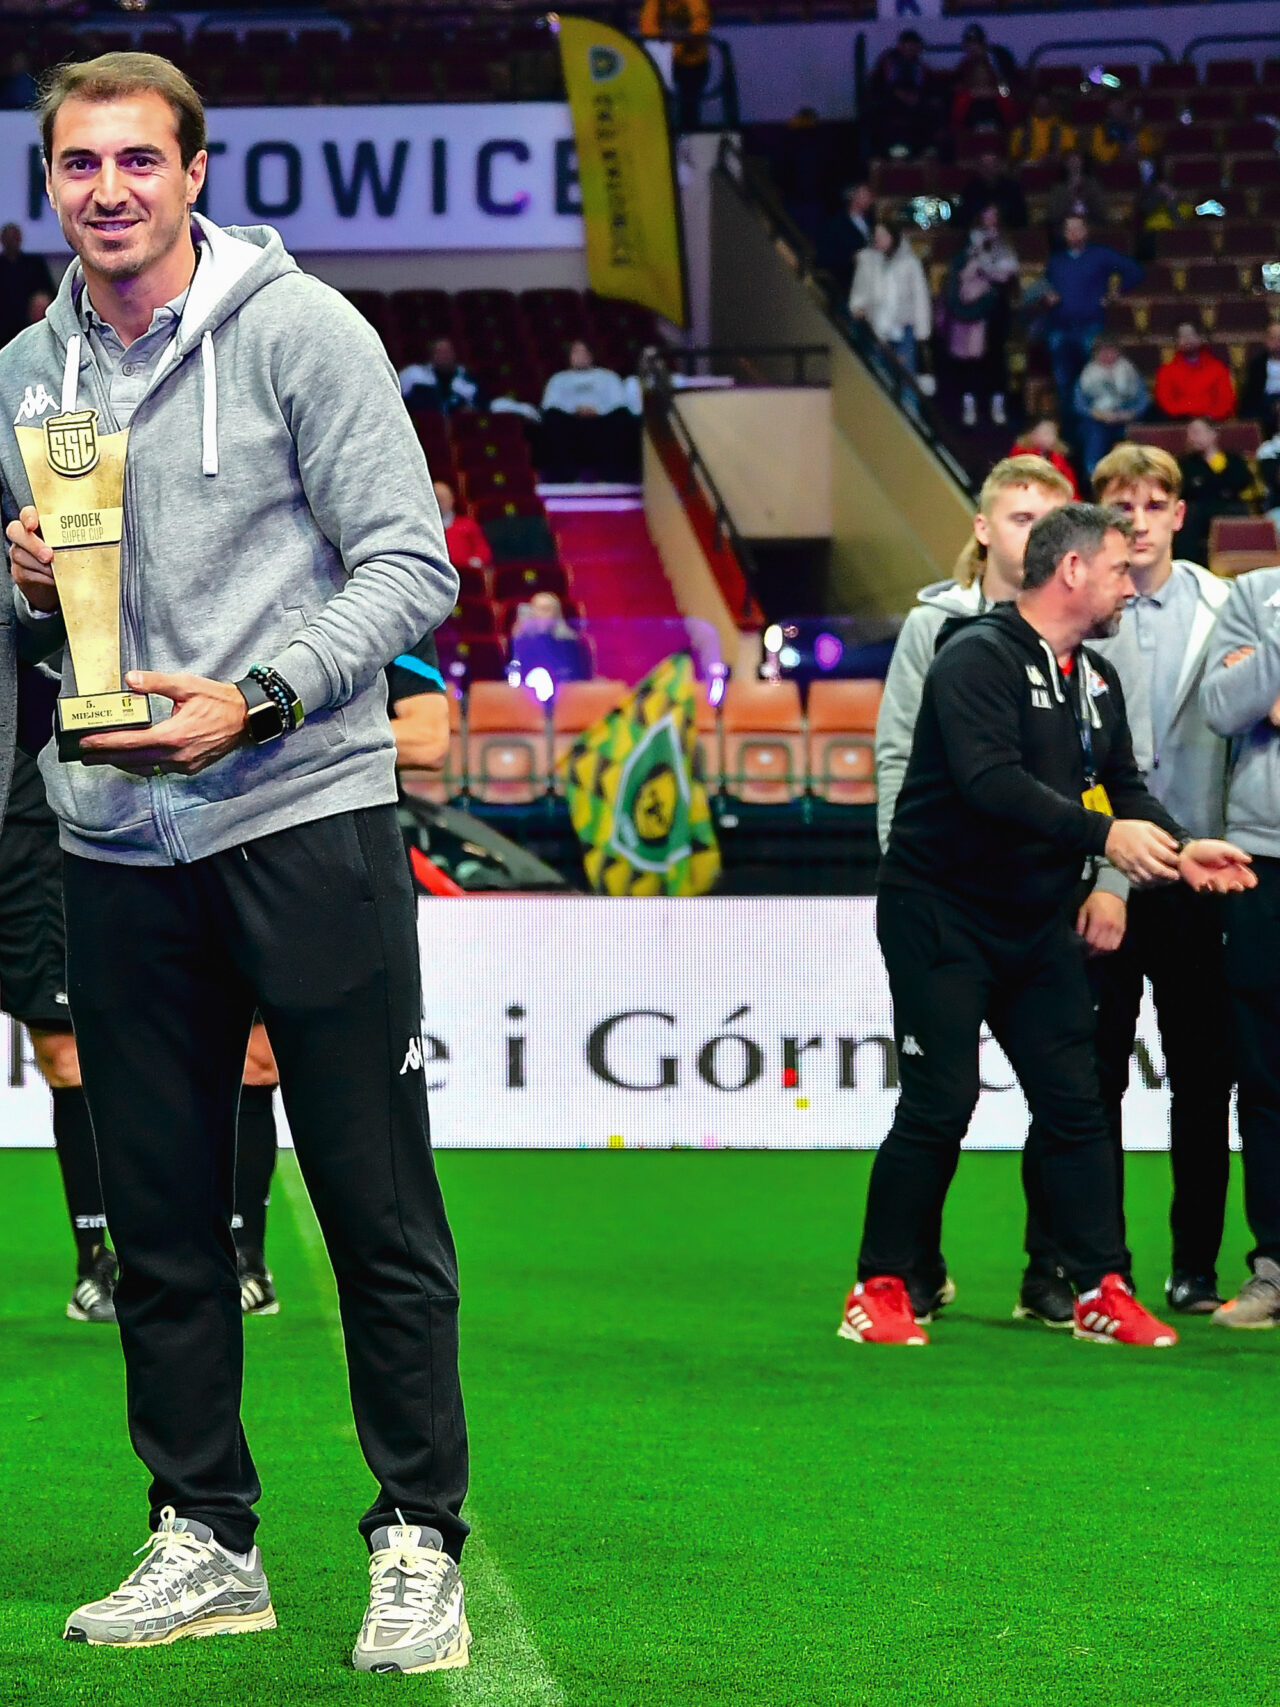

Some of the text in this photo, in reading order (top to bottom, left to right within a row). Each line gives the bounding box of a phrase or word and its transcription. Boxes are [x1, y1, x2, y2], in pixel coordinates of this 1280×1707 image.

[28, 138, 584, 219] TOWICE
[49, 428, 96, 470] SSC
[60, 512, 102, 529] SPODEK
[62, 527, 104, 543] SUPER CUP
[71, 709, 113, 721] MIEJSCE
[506, 1003, 526, 1090] i
[394, 1530, 413, 1538] NIE
